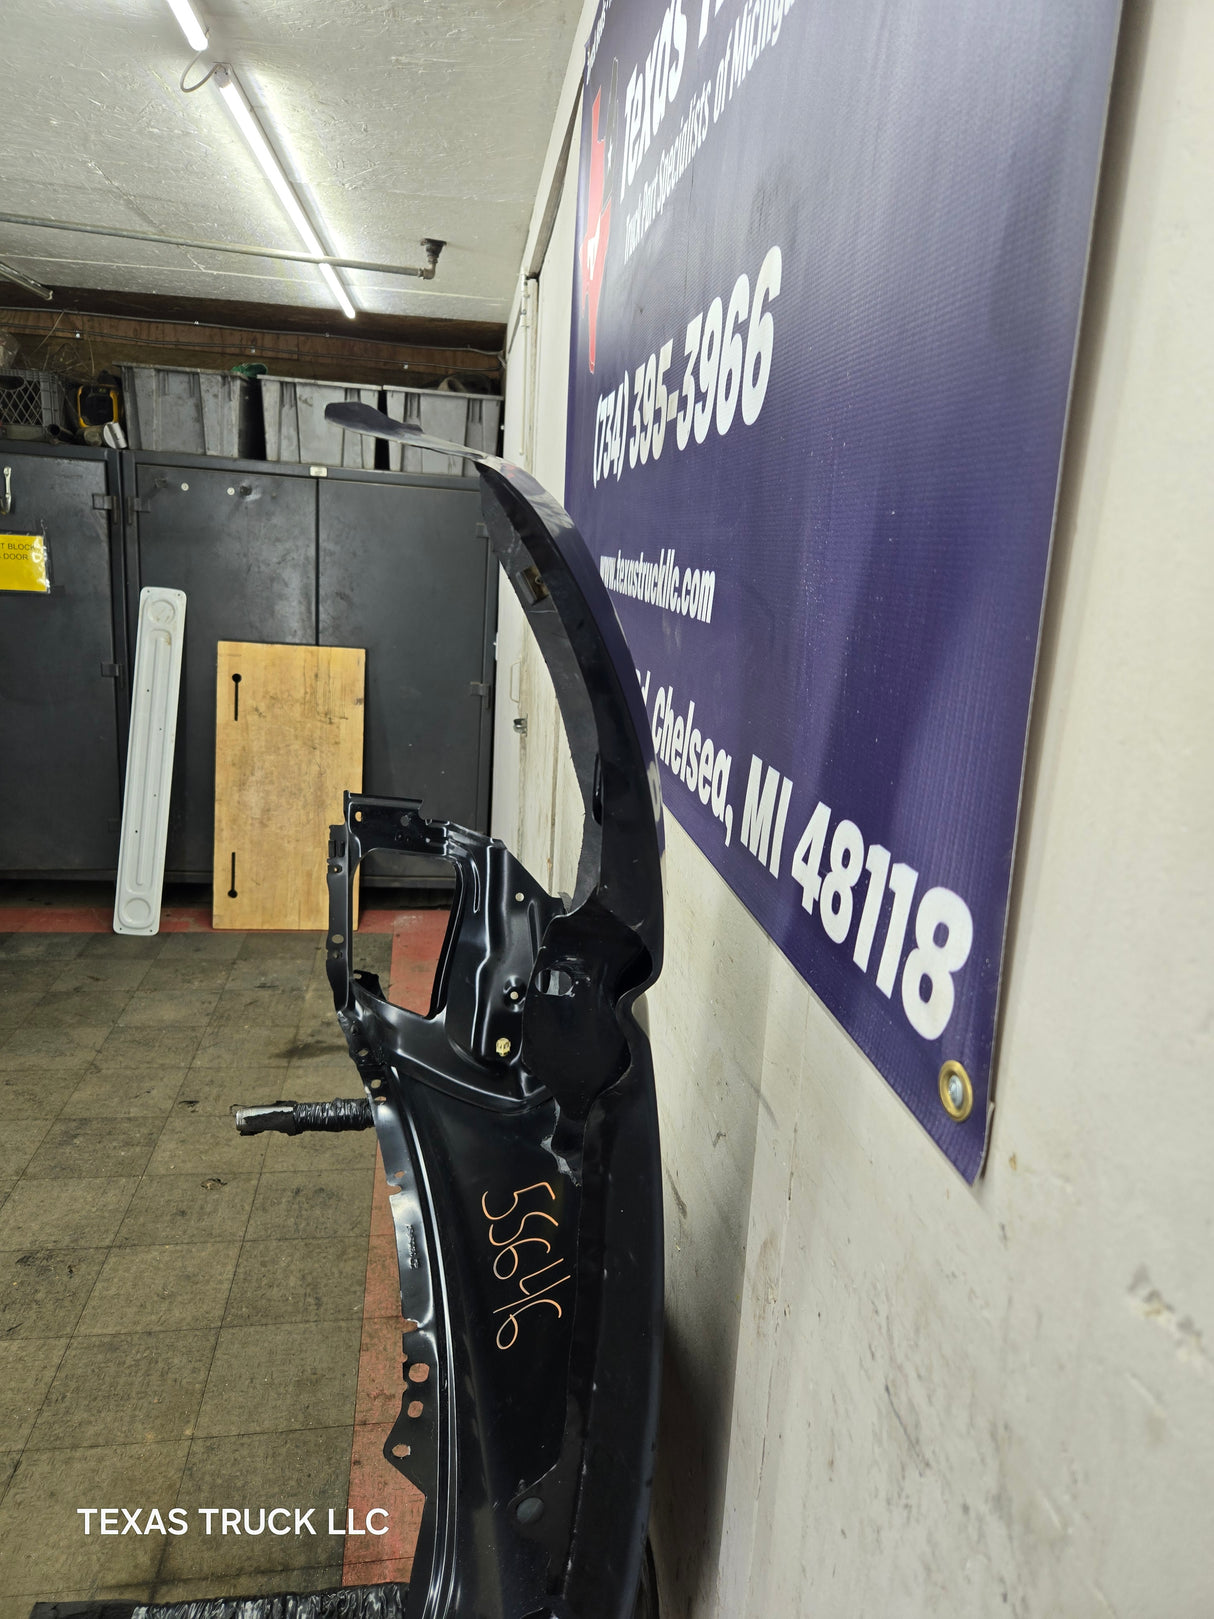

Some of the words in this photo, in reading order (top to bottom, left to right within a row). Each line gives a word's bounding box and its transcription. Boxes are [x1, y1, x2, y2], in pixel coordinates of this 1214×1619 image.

[620, 0, 688, 204] Texas
[656, 79, 712, 215] Specialists
[713, 28, 733, 123] of
[593, 370, 629, 489] (734)
[629, 245, 783, 470] 395-3966
[3, 553, 29, 561] DOOR
[600, 548, 716, 624] www.texastruckllc.com
[651, 685, 733, 848] Chelsea,
[740, 754, 793, 880] MI
[791, 801, 974, 1040] 48118
[481, 1181, 571, 1350] 55646
